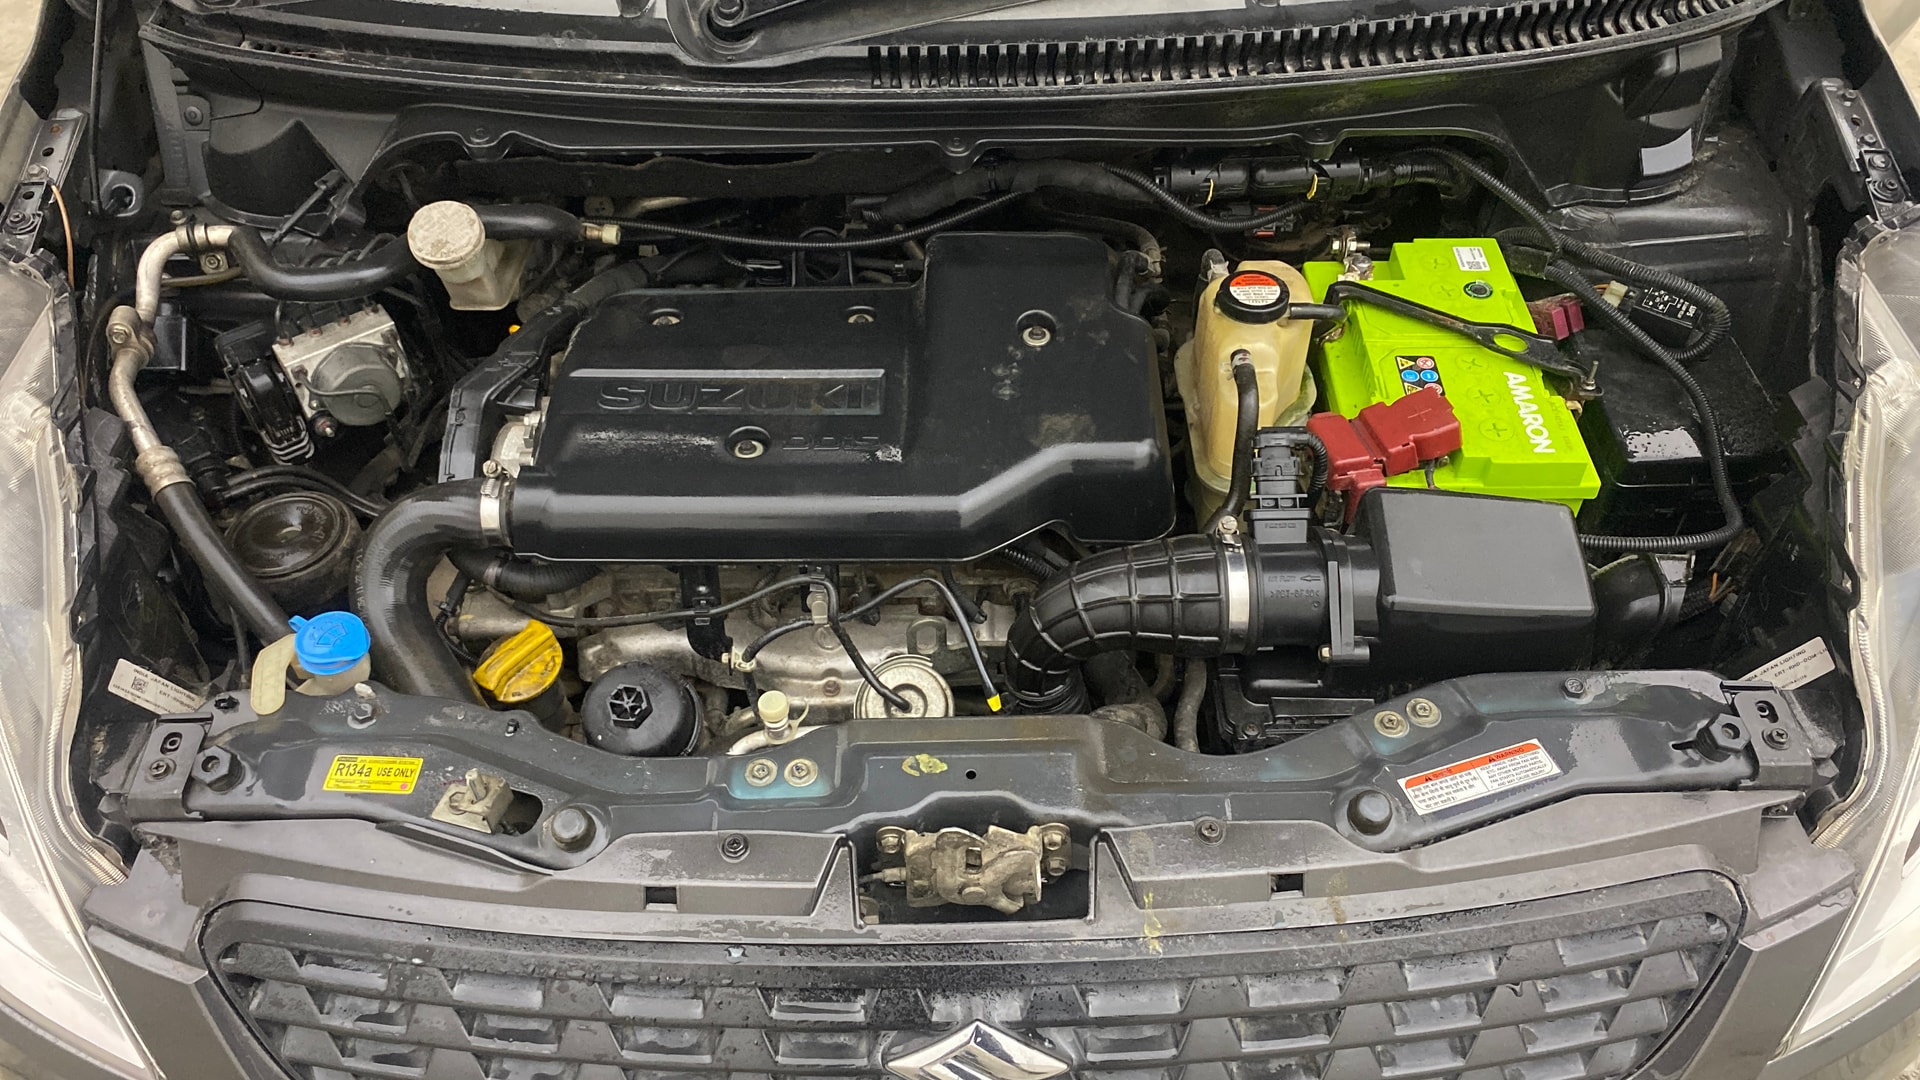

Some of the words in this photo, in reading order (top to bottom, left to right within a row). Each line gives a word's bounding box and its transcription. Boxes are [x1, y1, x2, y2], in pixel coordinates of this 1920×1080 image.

[597, 381, 868, 411] SUZUKI
[1503, 371, 1556, 453] AMARON
[334, 762, 373, 777] R134a
[376, 767, 393, 777] USE
[393, 767, 415, 778] ONLY
